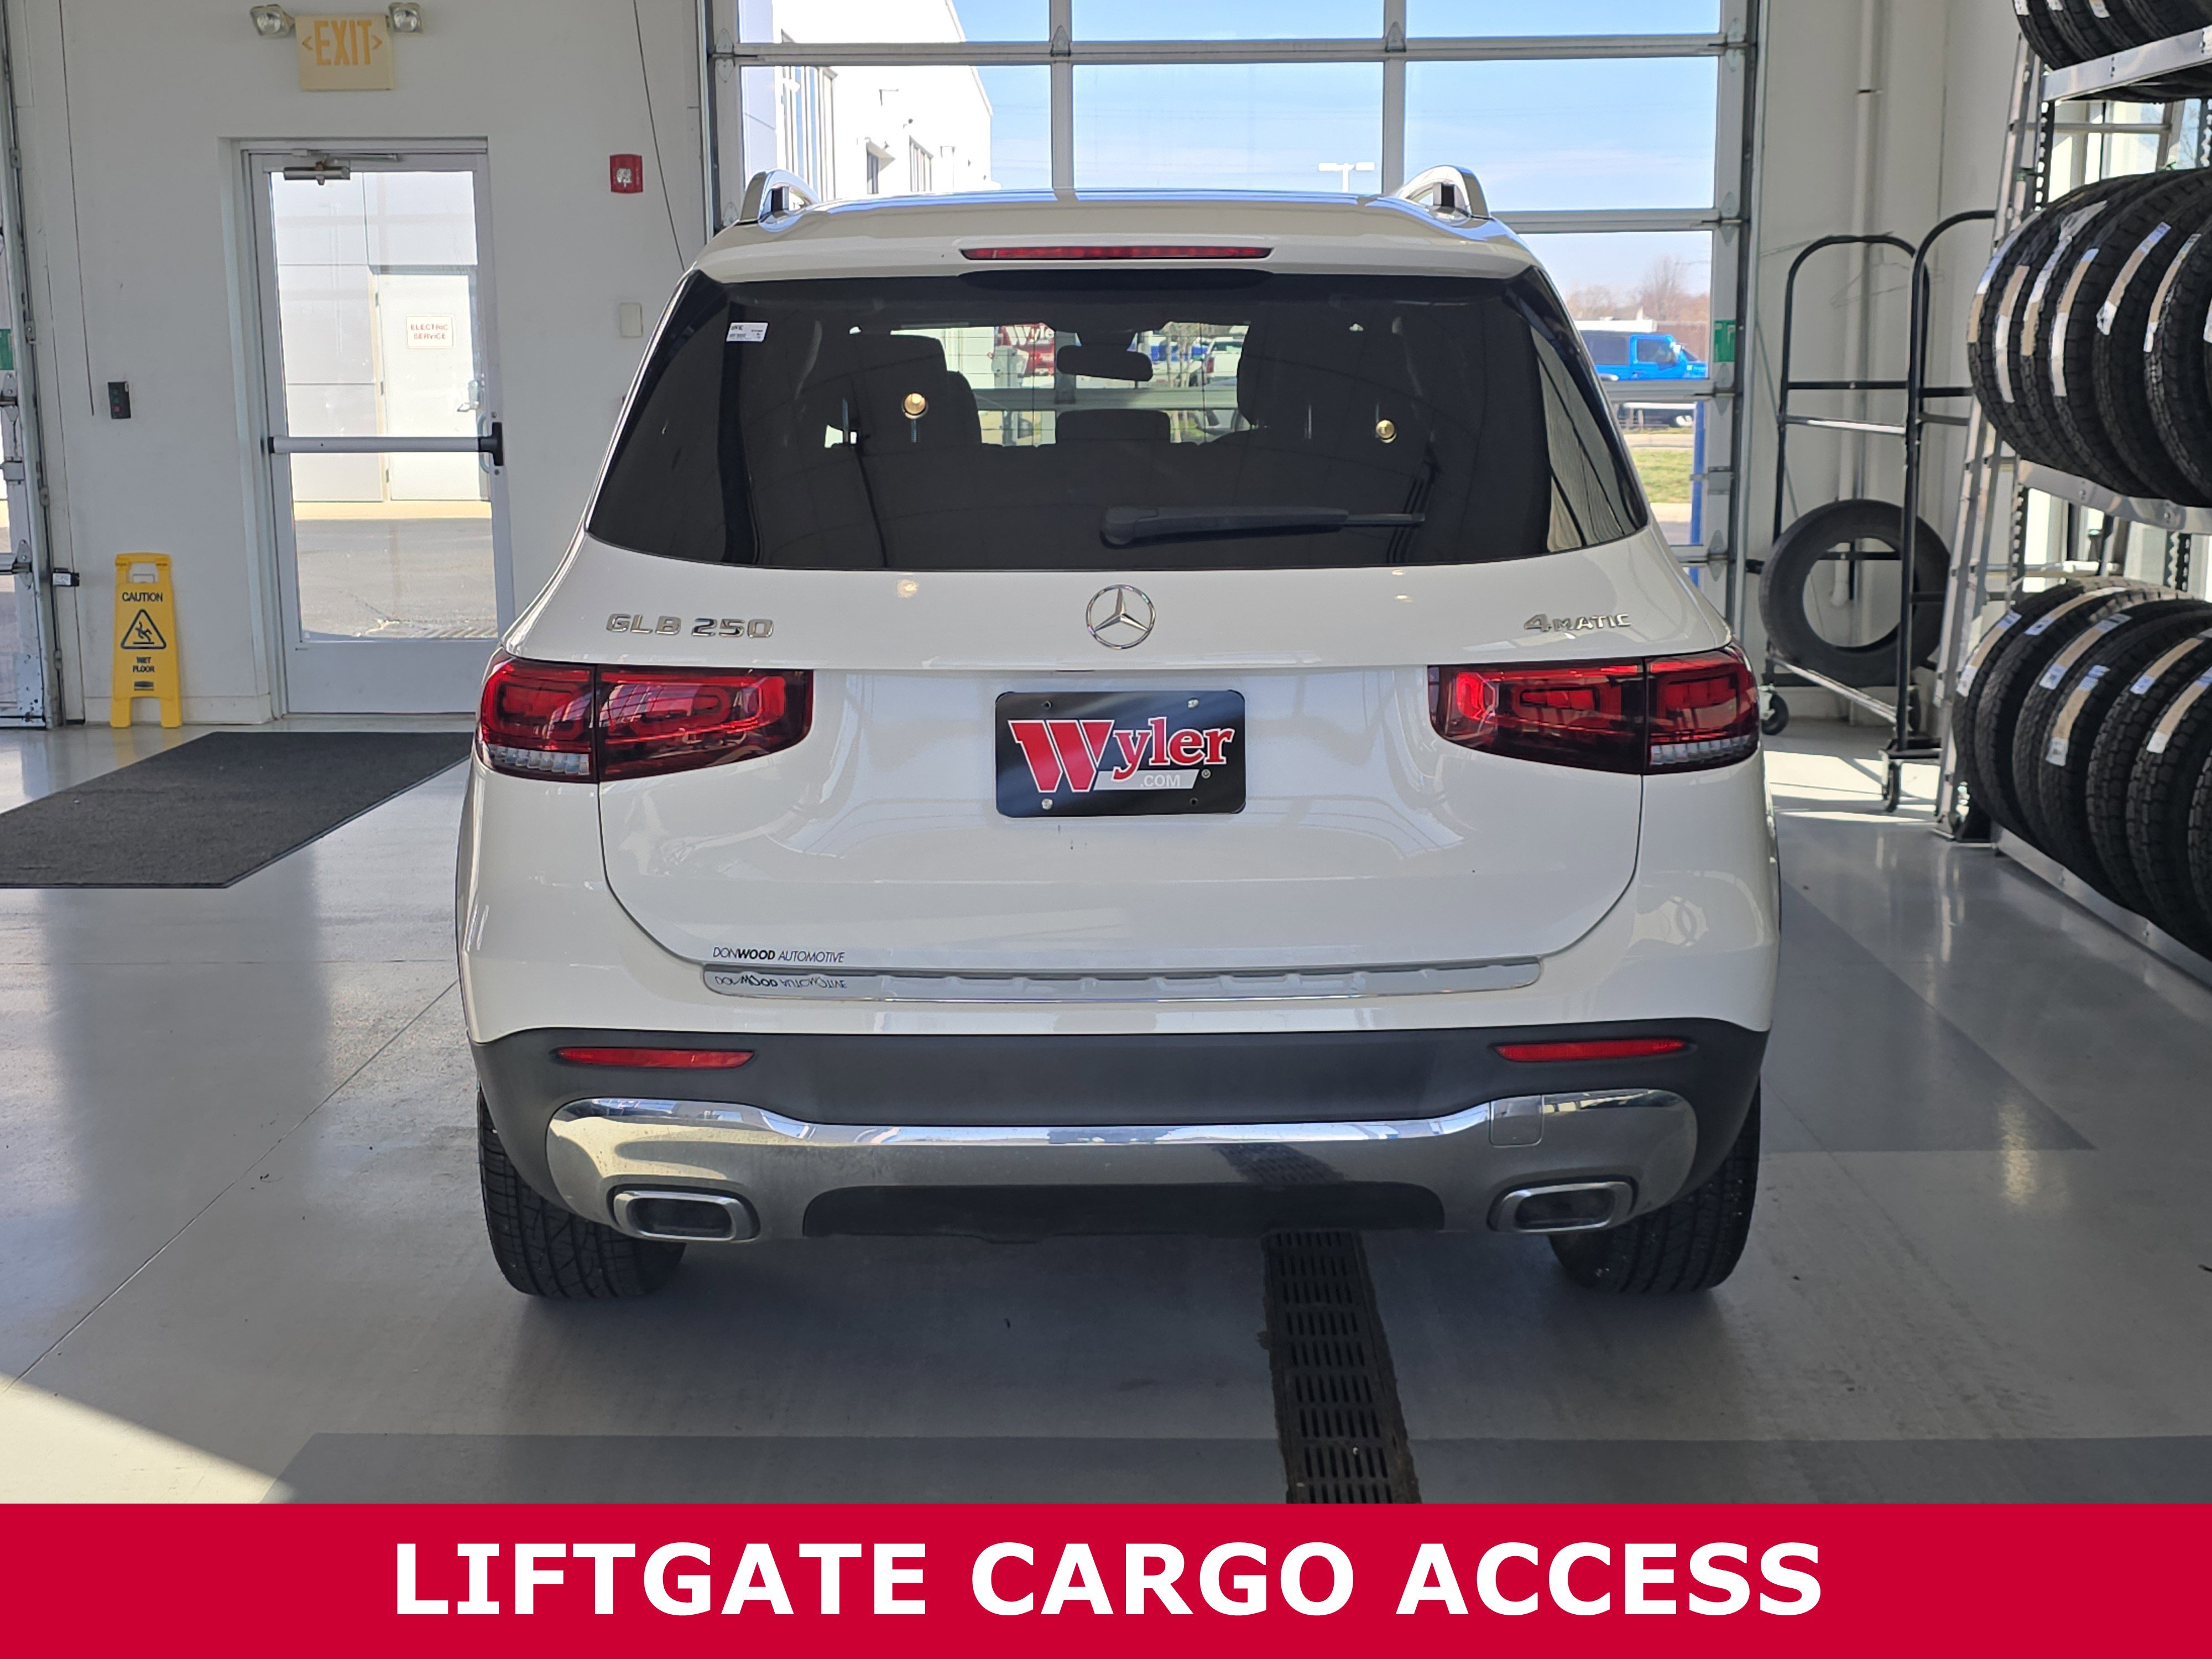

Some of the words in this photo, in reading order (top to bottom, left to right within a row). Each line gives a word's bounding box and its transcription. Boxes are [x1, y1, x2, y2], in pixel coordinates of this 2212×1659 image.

[314, 20, 372, 66] EXIT
[1005, 323, 1055, 346] Wyle
[122, 592, 163, 602] CAUTION
[606, 613, 682, 635] GLB
[691, 618, 774, 638] 250
[1524, 613, 1632, 632] 4MATIC
[1008, 717, 1235, 792] Wyler
[1140, 774, 1181, 787] .COM
[713, 947, 775, 960] DONWOOD
[778, 950, 845, 963] AUTOMOTIVE
